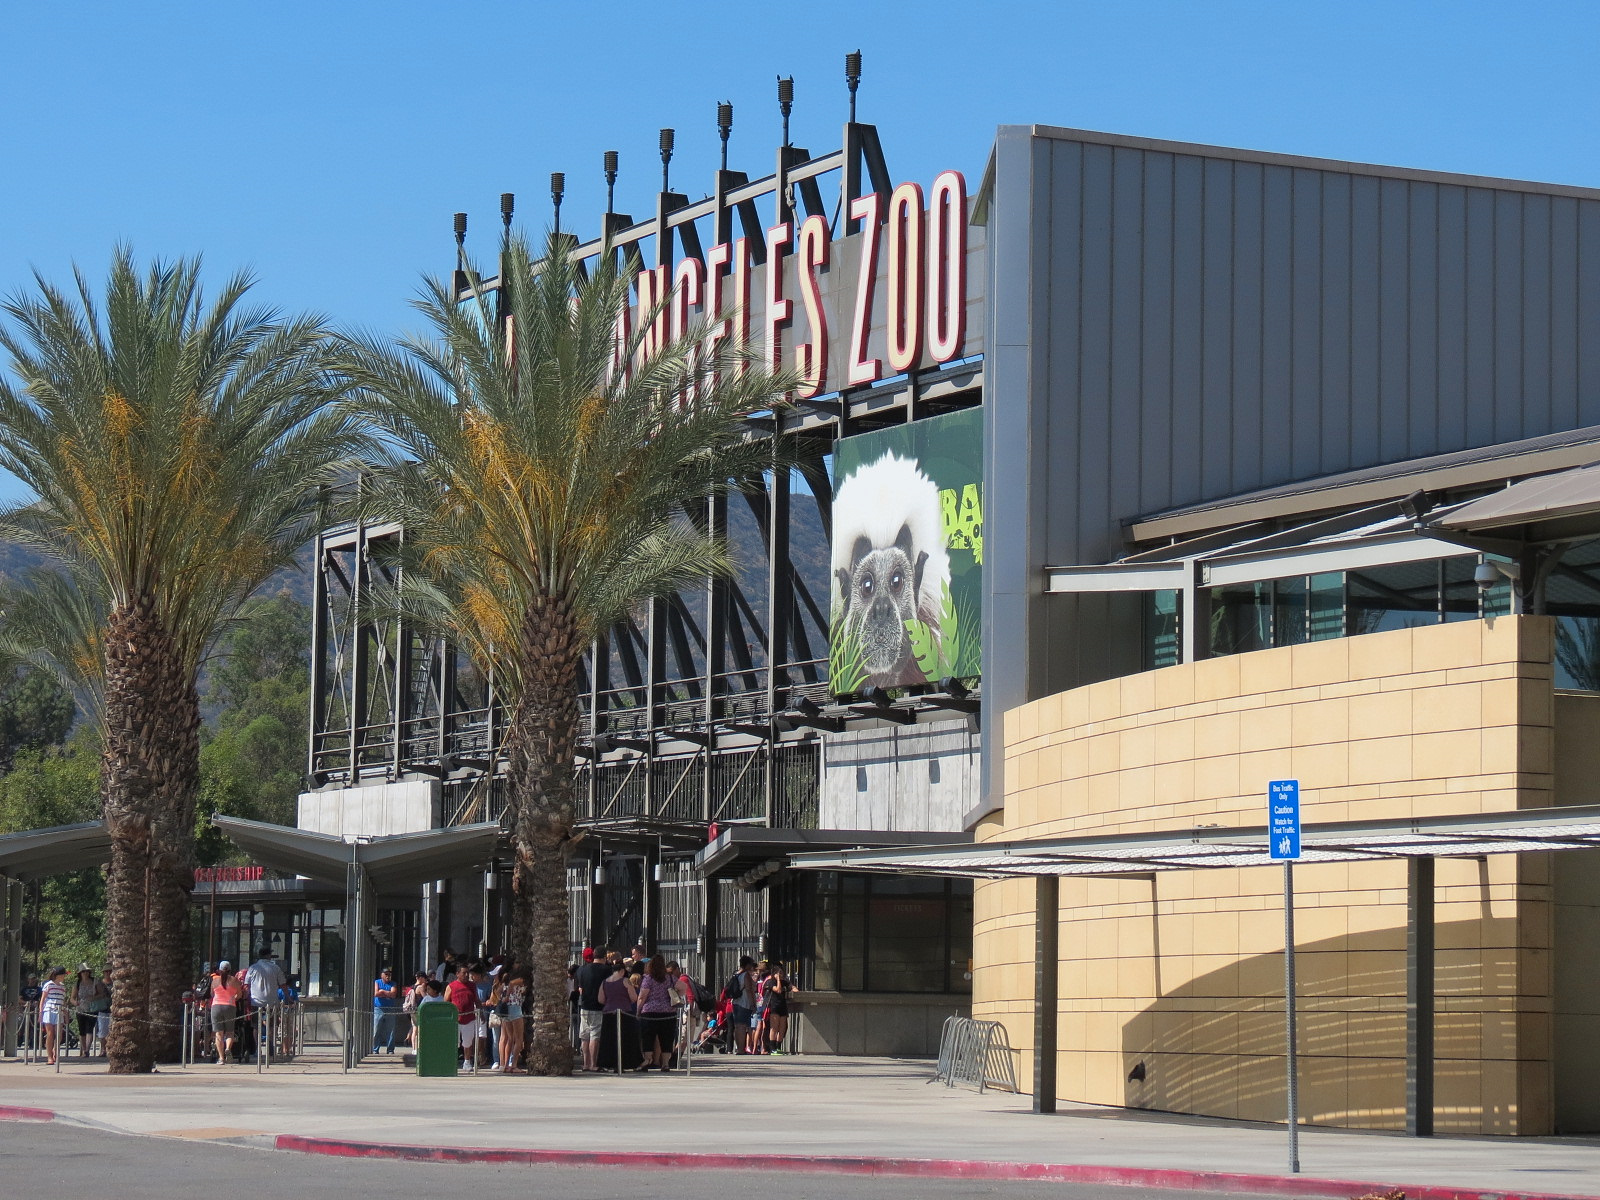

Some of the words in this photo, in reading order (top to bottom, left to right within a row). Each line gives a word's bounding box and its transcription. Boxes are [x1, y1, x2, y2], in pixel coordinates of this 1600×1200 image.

[848, 170, 967, 386] ZOO
[1279, 793, 1288, 801] Only
[1274, 805, 1293, 814] Caution
